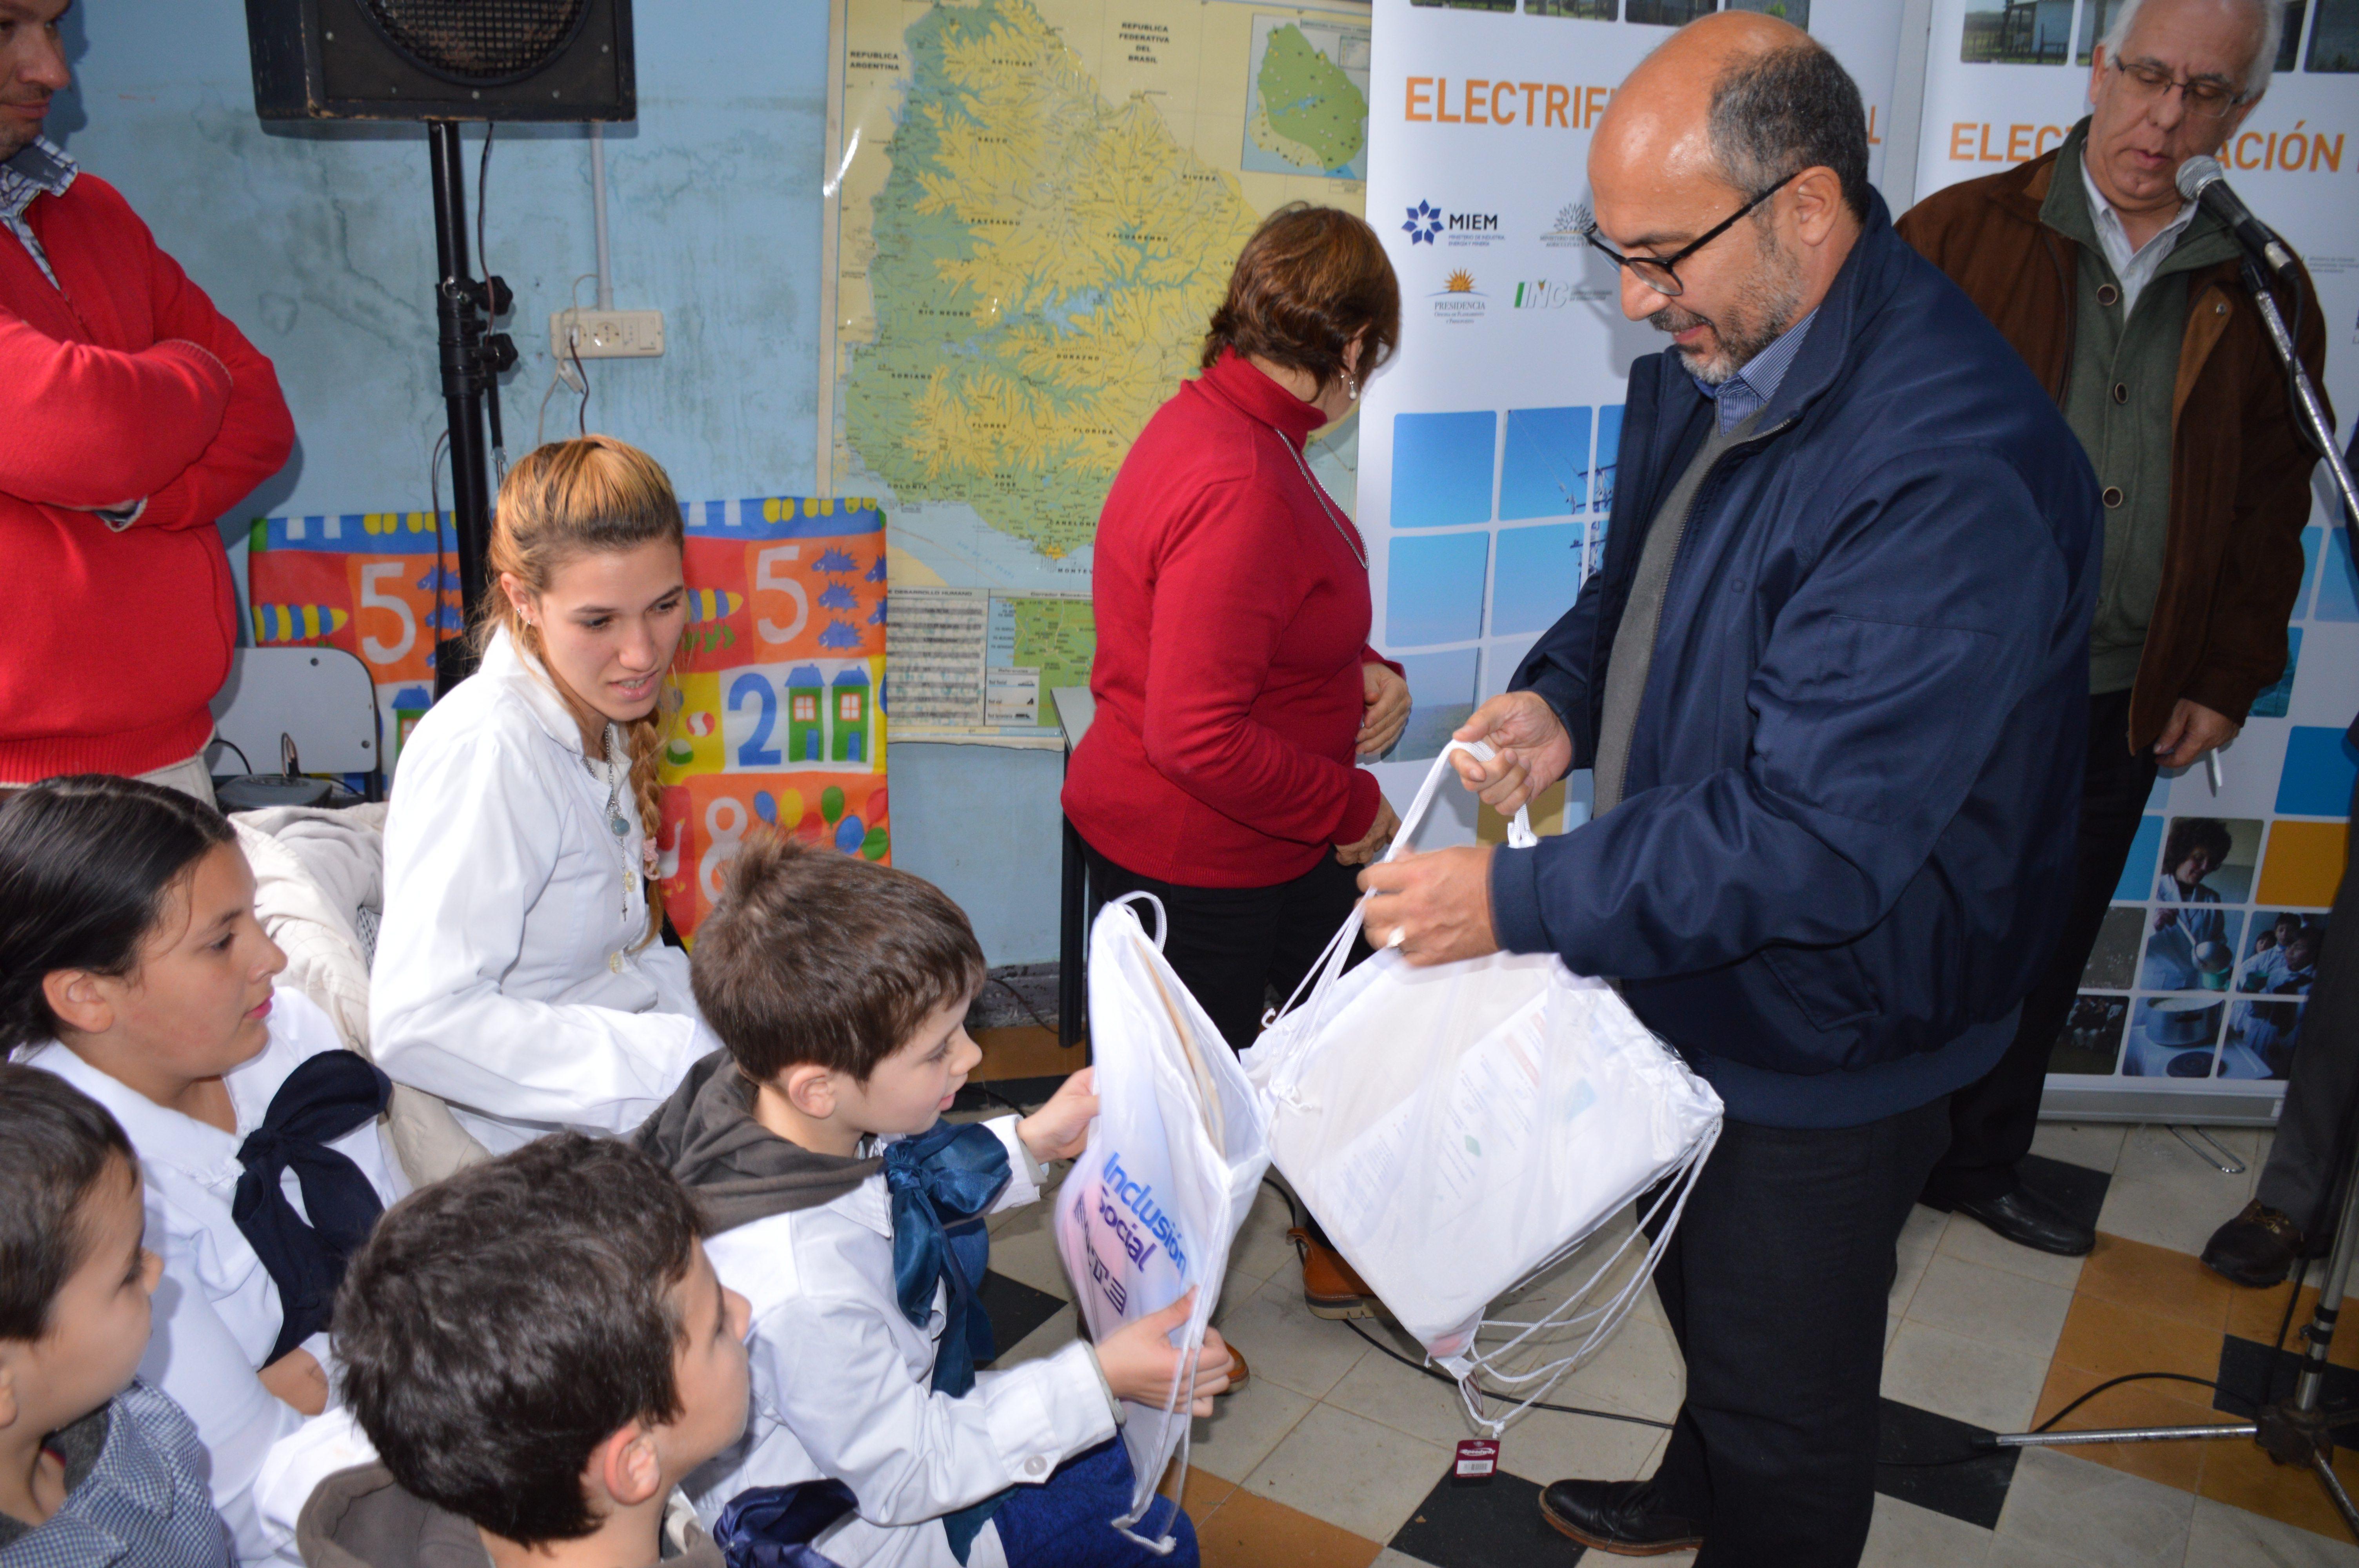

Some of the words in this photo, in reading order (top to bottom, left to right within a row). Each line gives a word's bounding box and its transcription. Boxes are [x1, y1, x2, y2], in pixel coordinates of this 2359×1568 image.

[1122, 22, 1168, 32] REPUBLICA
[1119, 33, 1170, 44] FEDERATIVA
[850, 51, 898, 60] REPUBLICA
[1128, 55, 1158, 64] BRASIL
[849, 62, 900, 71] ARGENTINA
[1405, 76, 1616, 129] ELECTRIF
[1949, 123, 2074, 162] ELEC
[1182, 174, 1216, 182] RIVERA
[1449, 214, 1498, 230] MIEM
[1435, 301, 1485, 310] PRESIDENCIA
[756, 545, 809, 645] 5
[360, 561, 416, 664] 5
[728, 673, 781, 766] 2
[699, 797, 748, 909] 8
